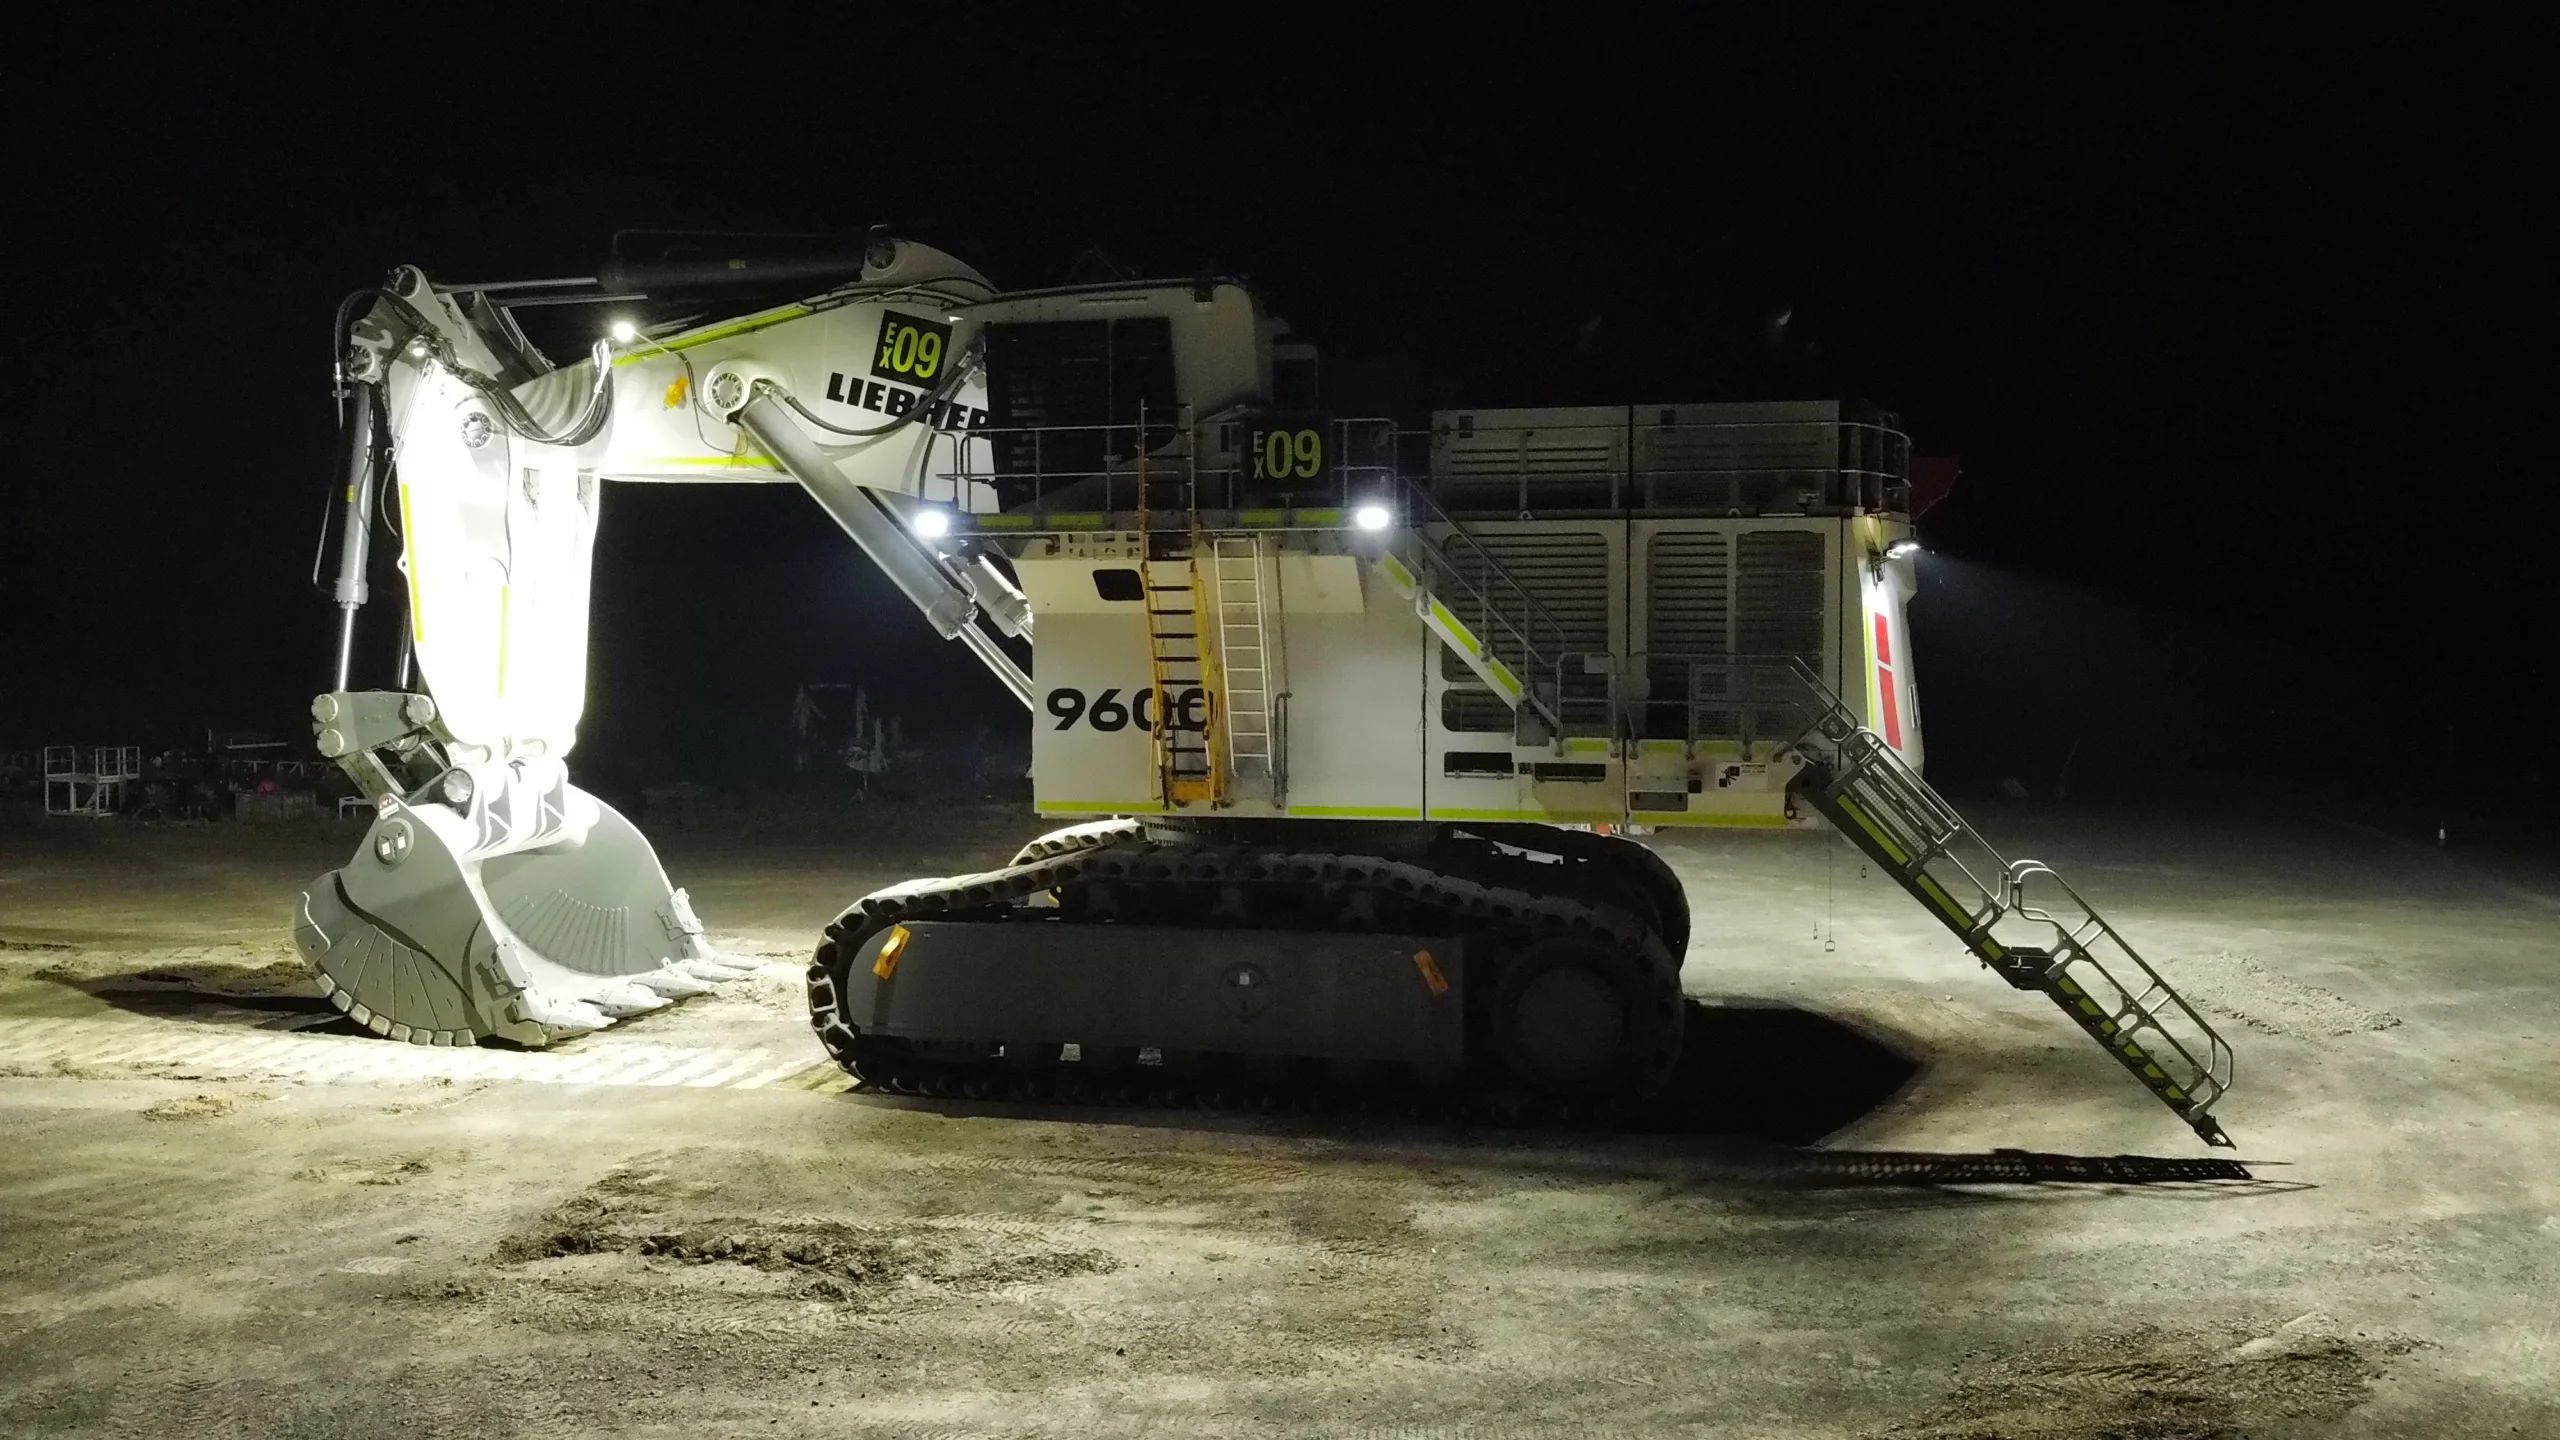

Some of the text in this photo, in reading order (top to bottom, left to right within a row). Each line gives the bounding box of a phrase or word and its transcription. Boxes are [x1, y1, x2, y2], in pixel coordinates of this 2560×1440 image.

[892, 326, 943, 379] 09
[1266, 429, 1322, 479] 09
[1046, 687, 1214, 732] 9600
